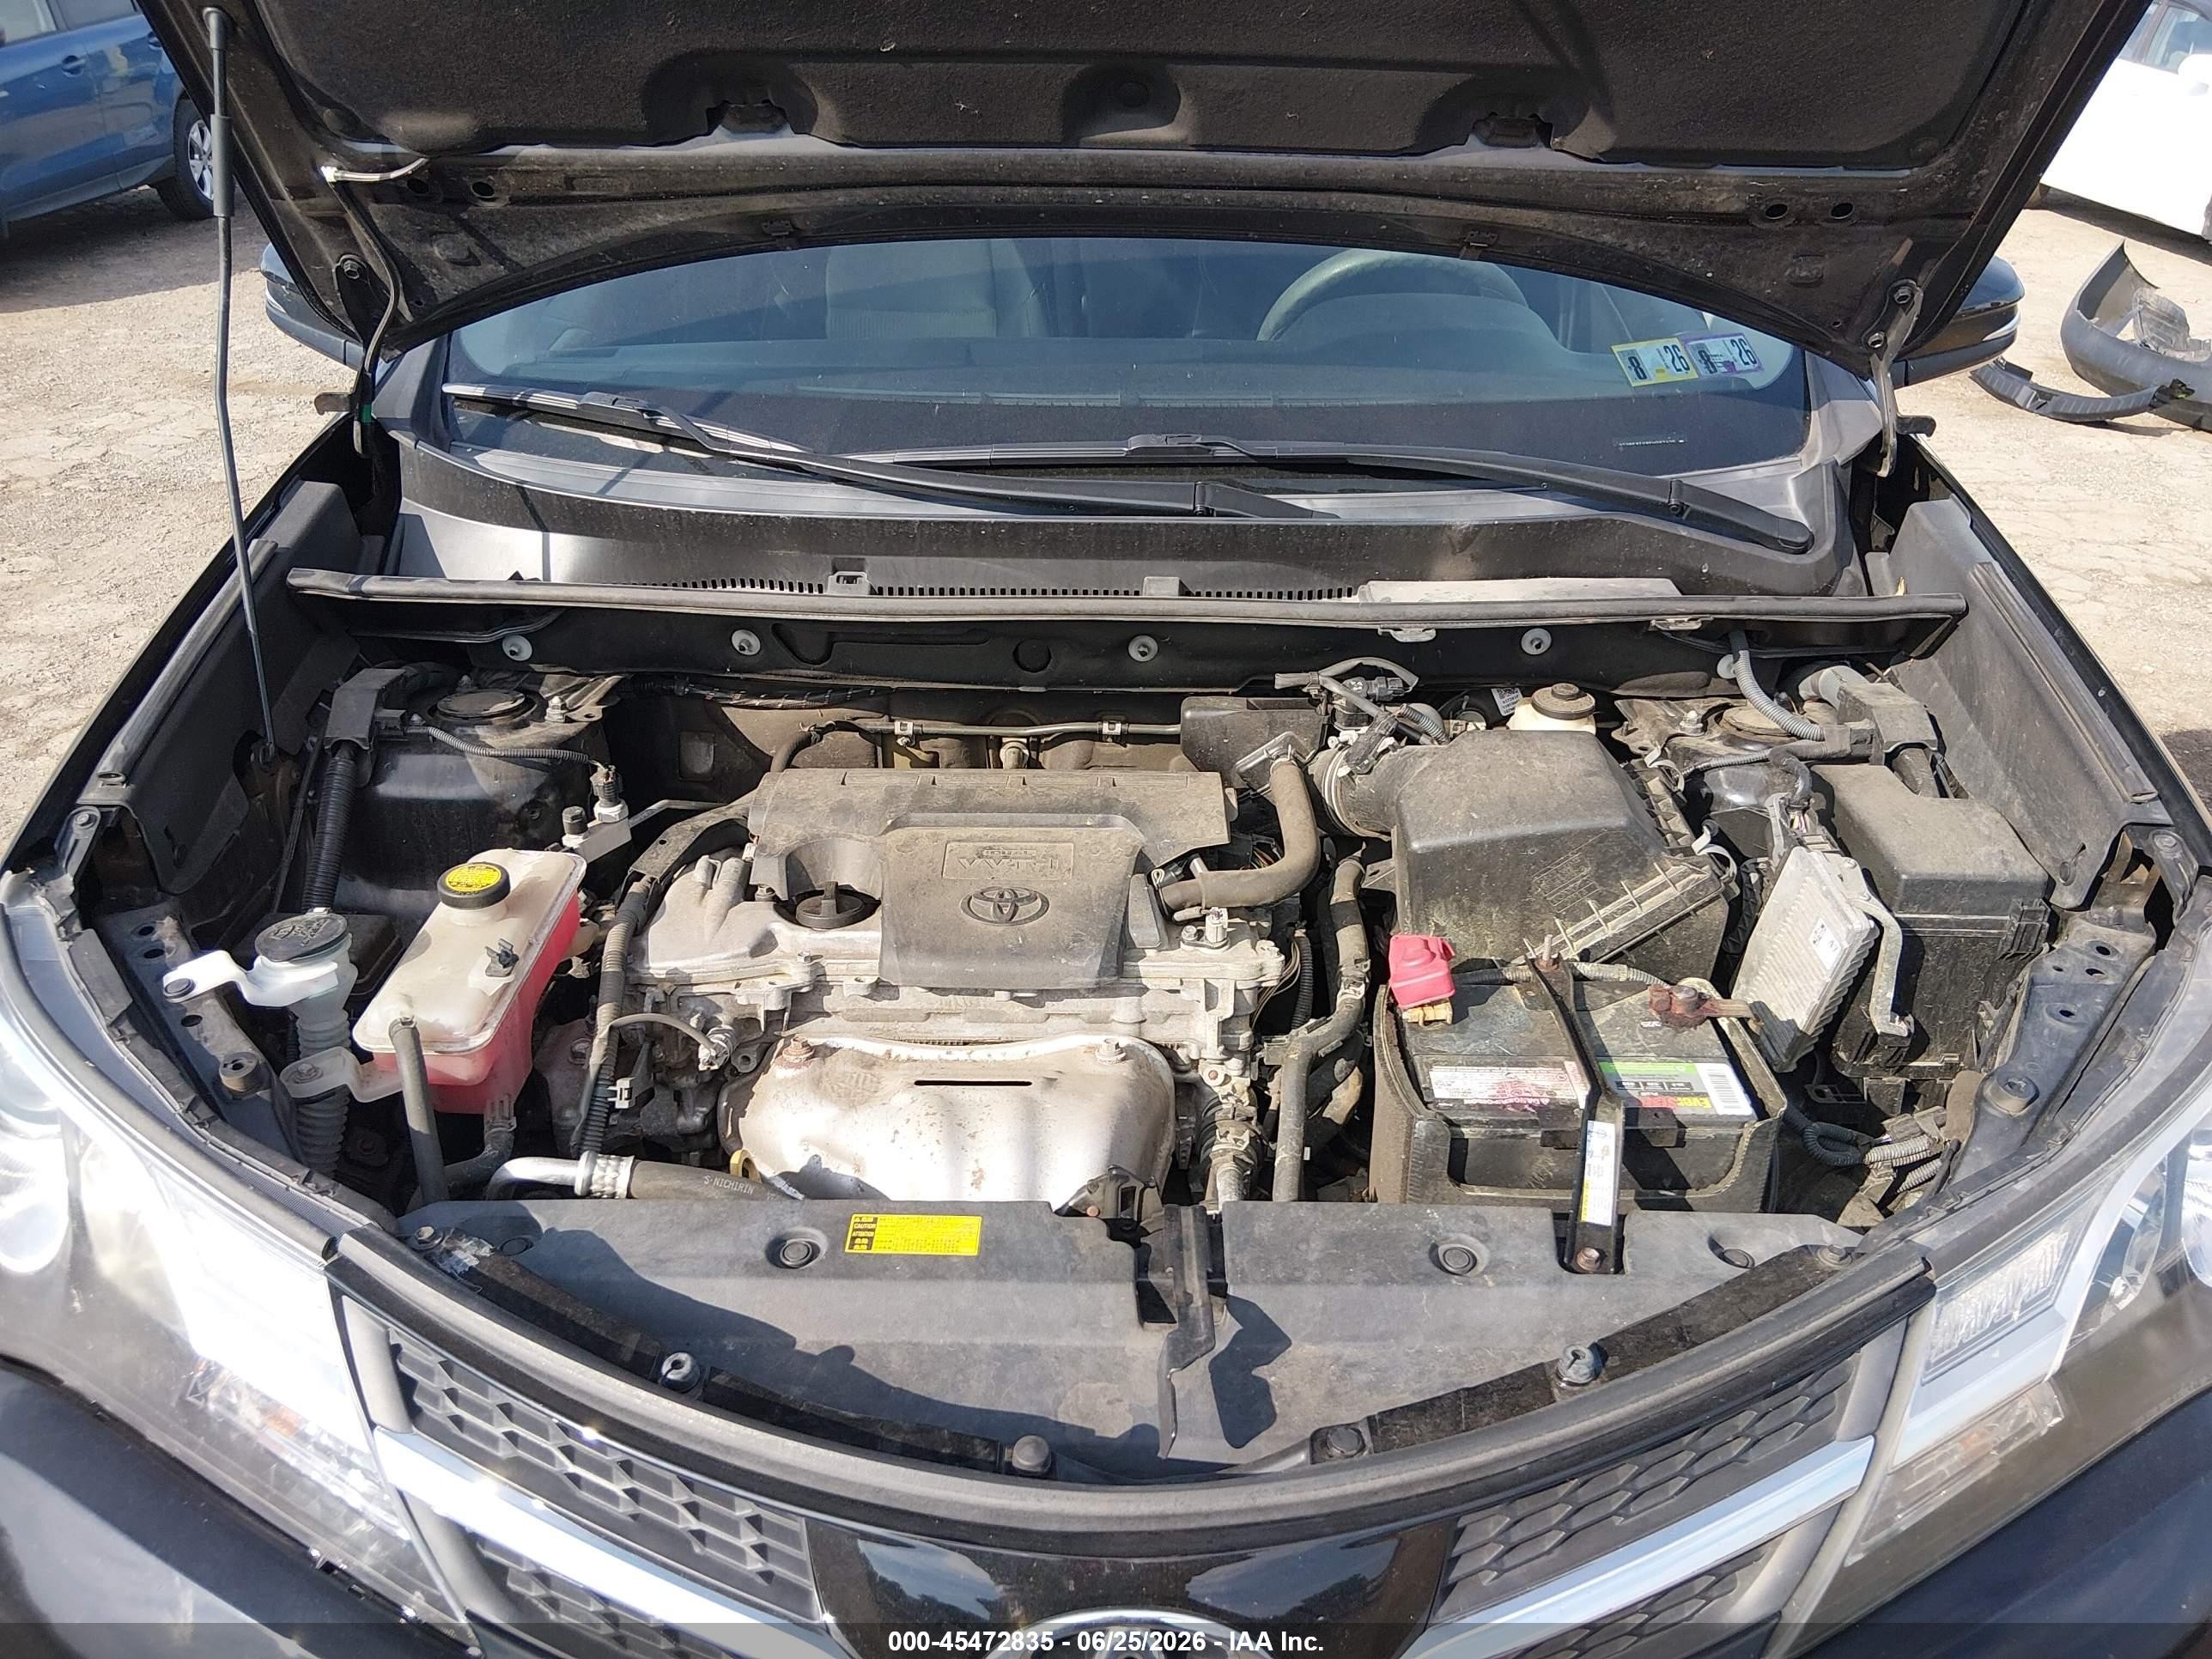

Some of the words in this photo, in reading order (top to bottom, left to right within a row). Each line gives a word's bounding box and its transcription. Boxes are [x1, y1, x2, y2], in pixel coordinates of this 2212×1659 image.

[1628, 356, 1648, 380] 8
[1663, 344, 1691, 373] 26
[1698, 349, 1718, 374] 8
[1730, 337, 1758, 366] 26
